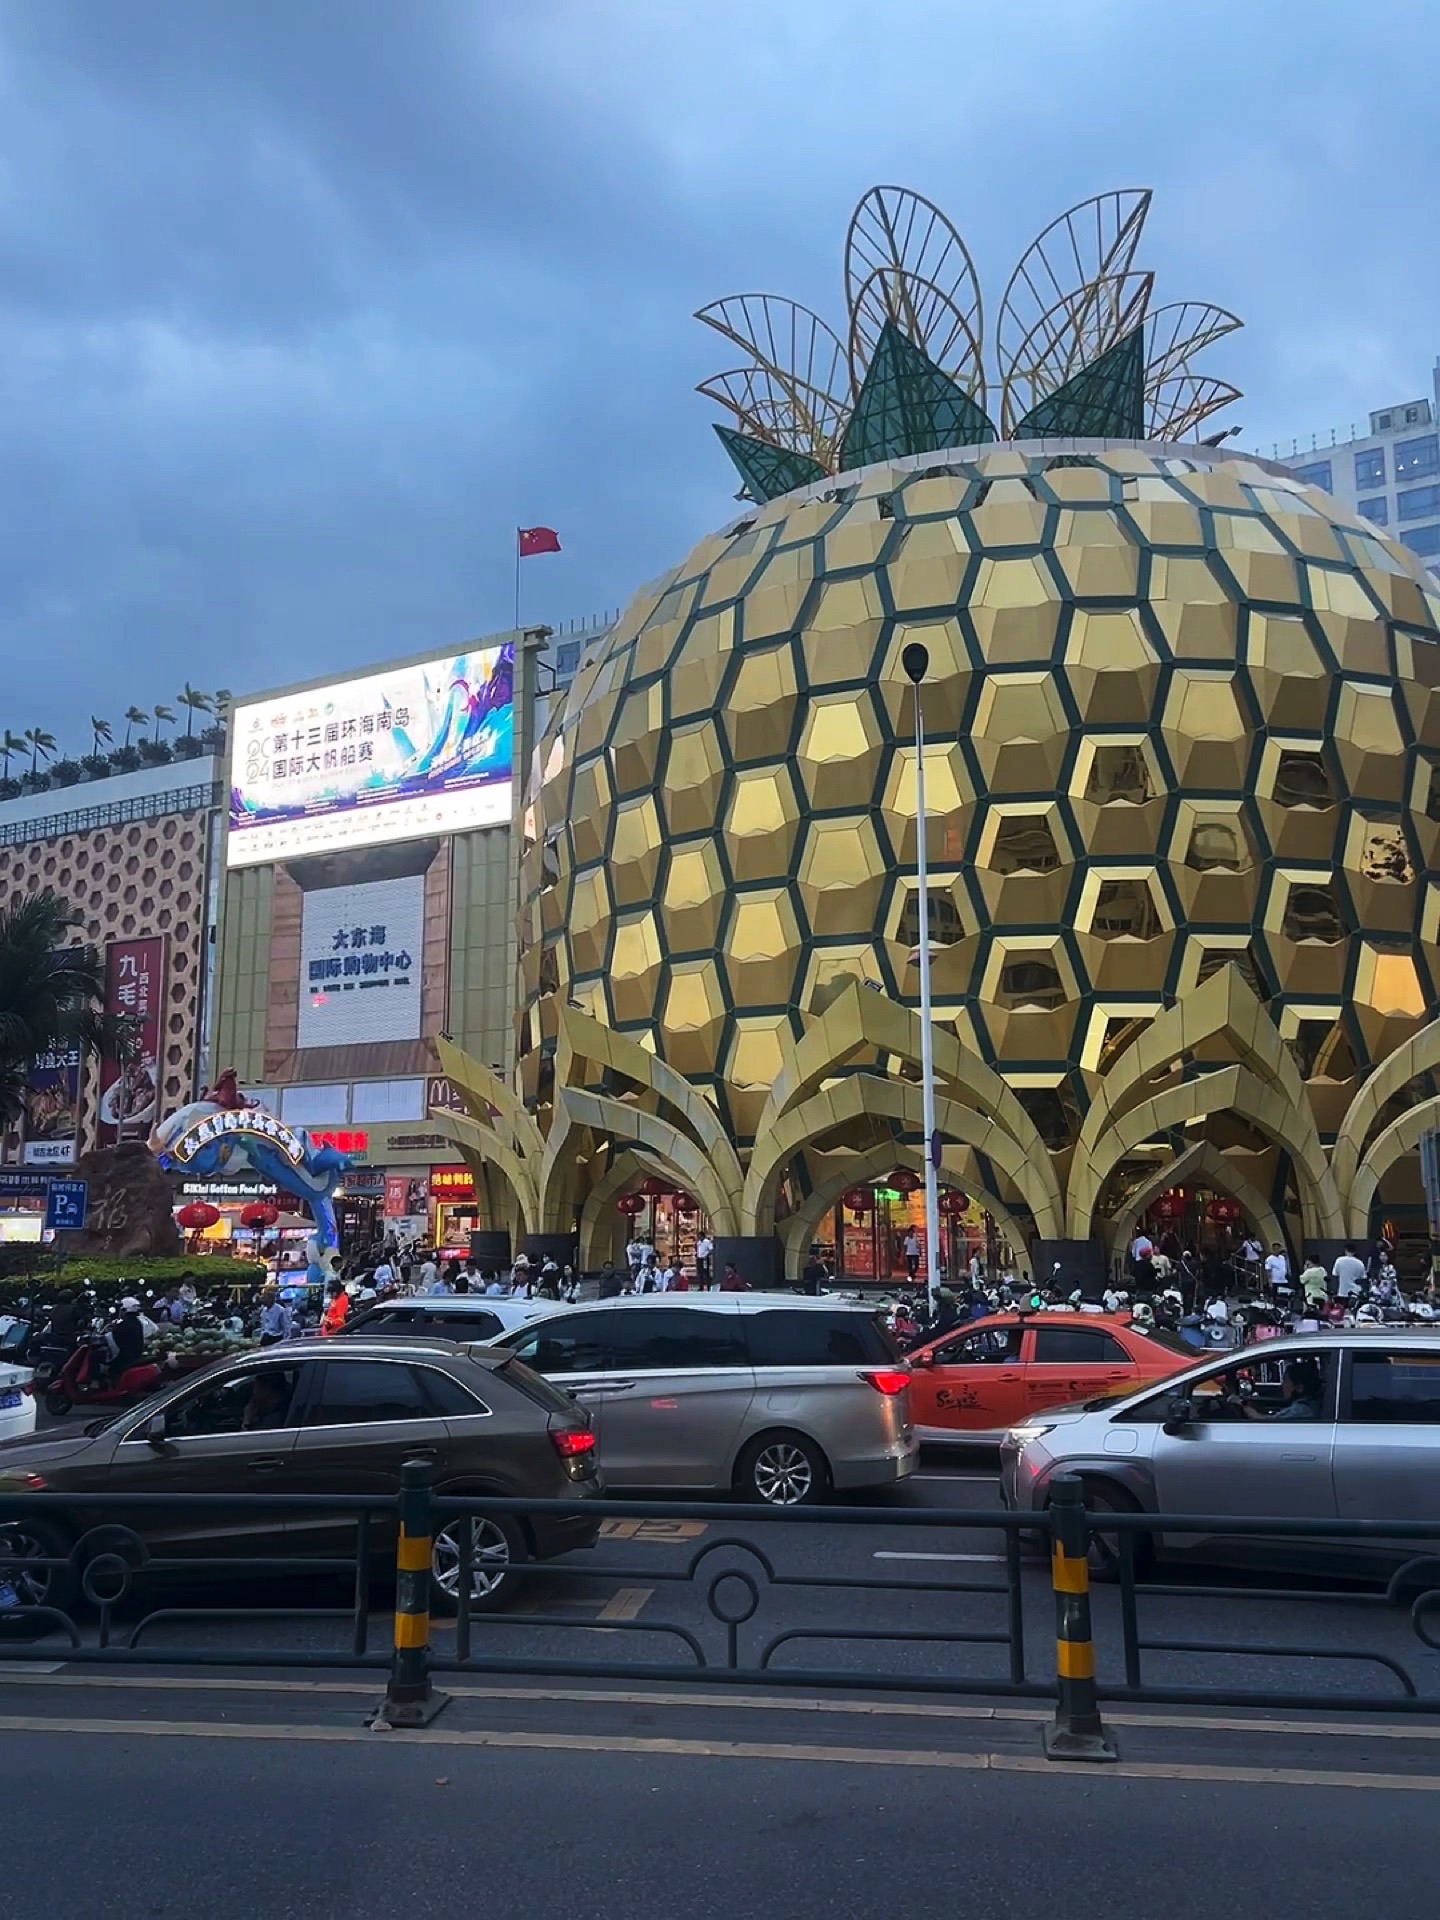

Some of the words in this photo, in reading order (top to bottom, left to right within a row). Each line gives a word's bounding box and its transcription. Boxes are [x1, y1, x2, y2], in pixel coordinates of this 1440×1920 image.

[273, 707, 410, 754] 第十三届环海南岛
[272, 741, 374, 779] 国际大帆船赛
[332, 924, 387, 950] 大东海
[309, 949, 412, 980] 国际购物中心
[55, 1195, 68, 1214] P
